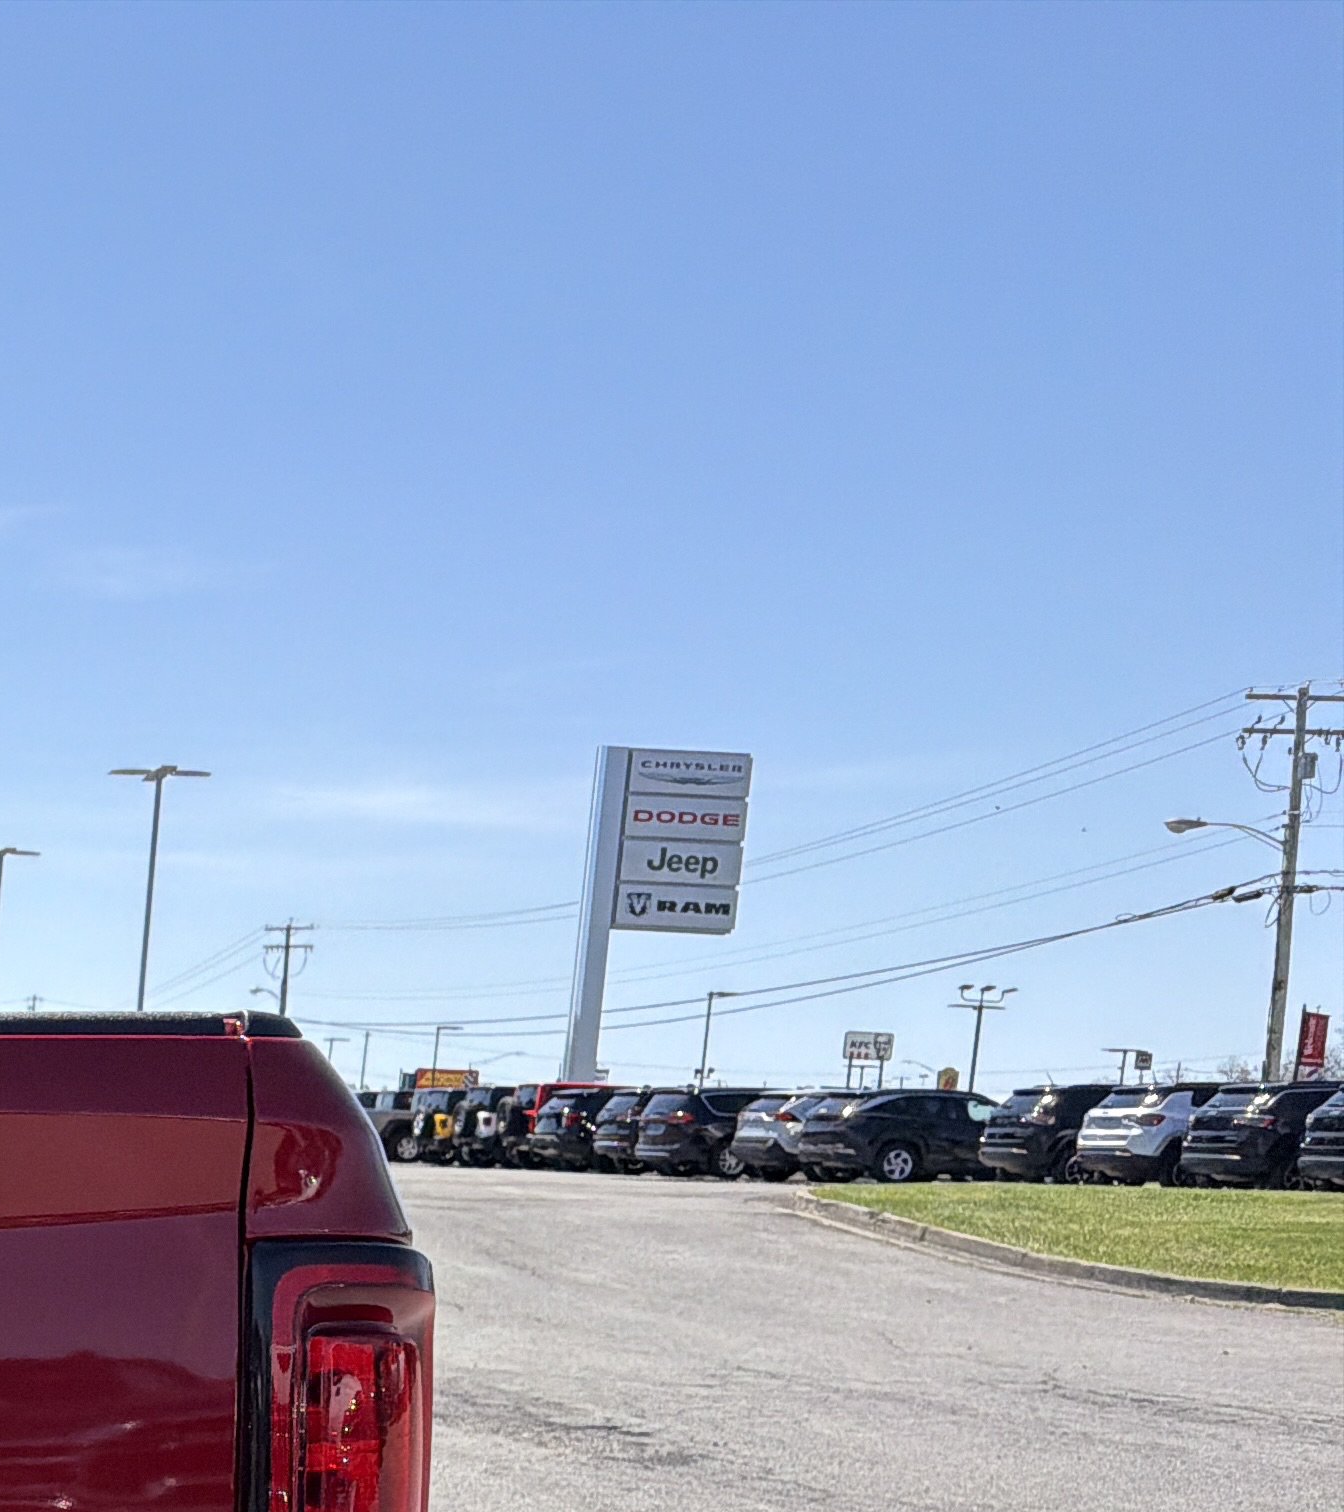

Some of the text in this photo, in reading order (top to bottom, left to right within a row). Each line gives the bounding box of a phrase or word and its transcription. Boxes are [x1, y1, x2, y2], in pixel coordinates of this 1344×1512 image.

[640, 759, 743, 773] CHRYSLER
[632, 809, 740, 827] DODGE
[647, 847, 719, 879] Jeep
[656, 900, 731, 916] RAM
